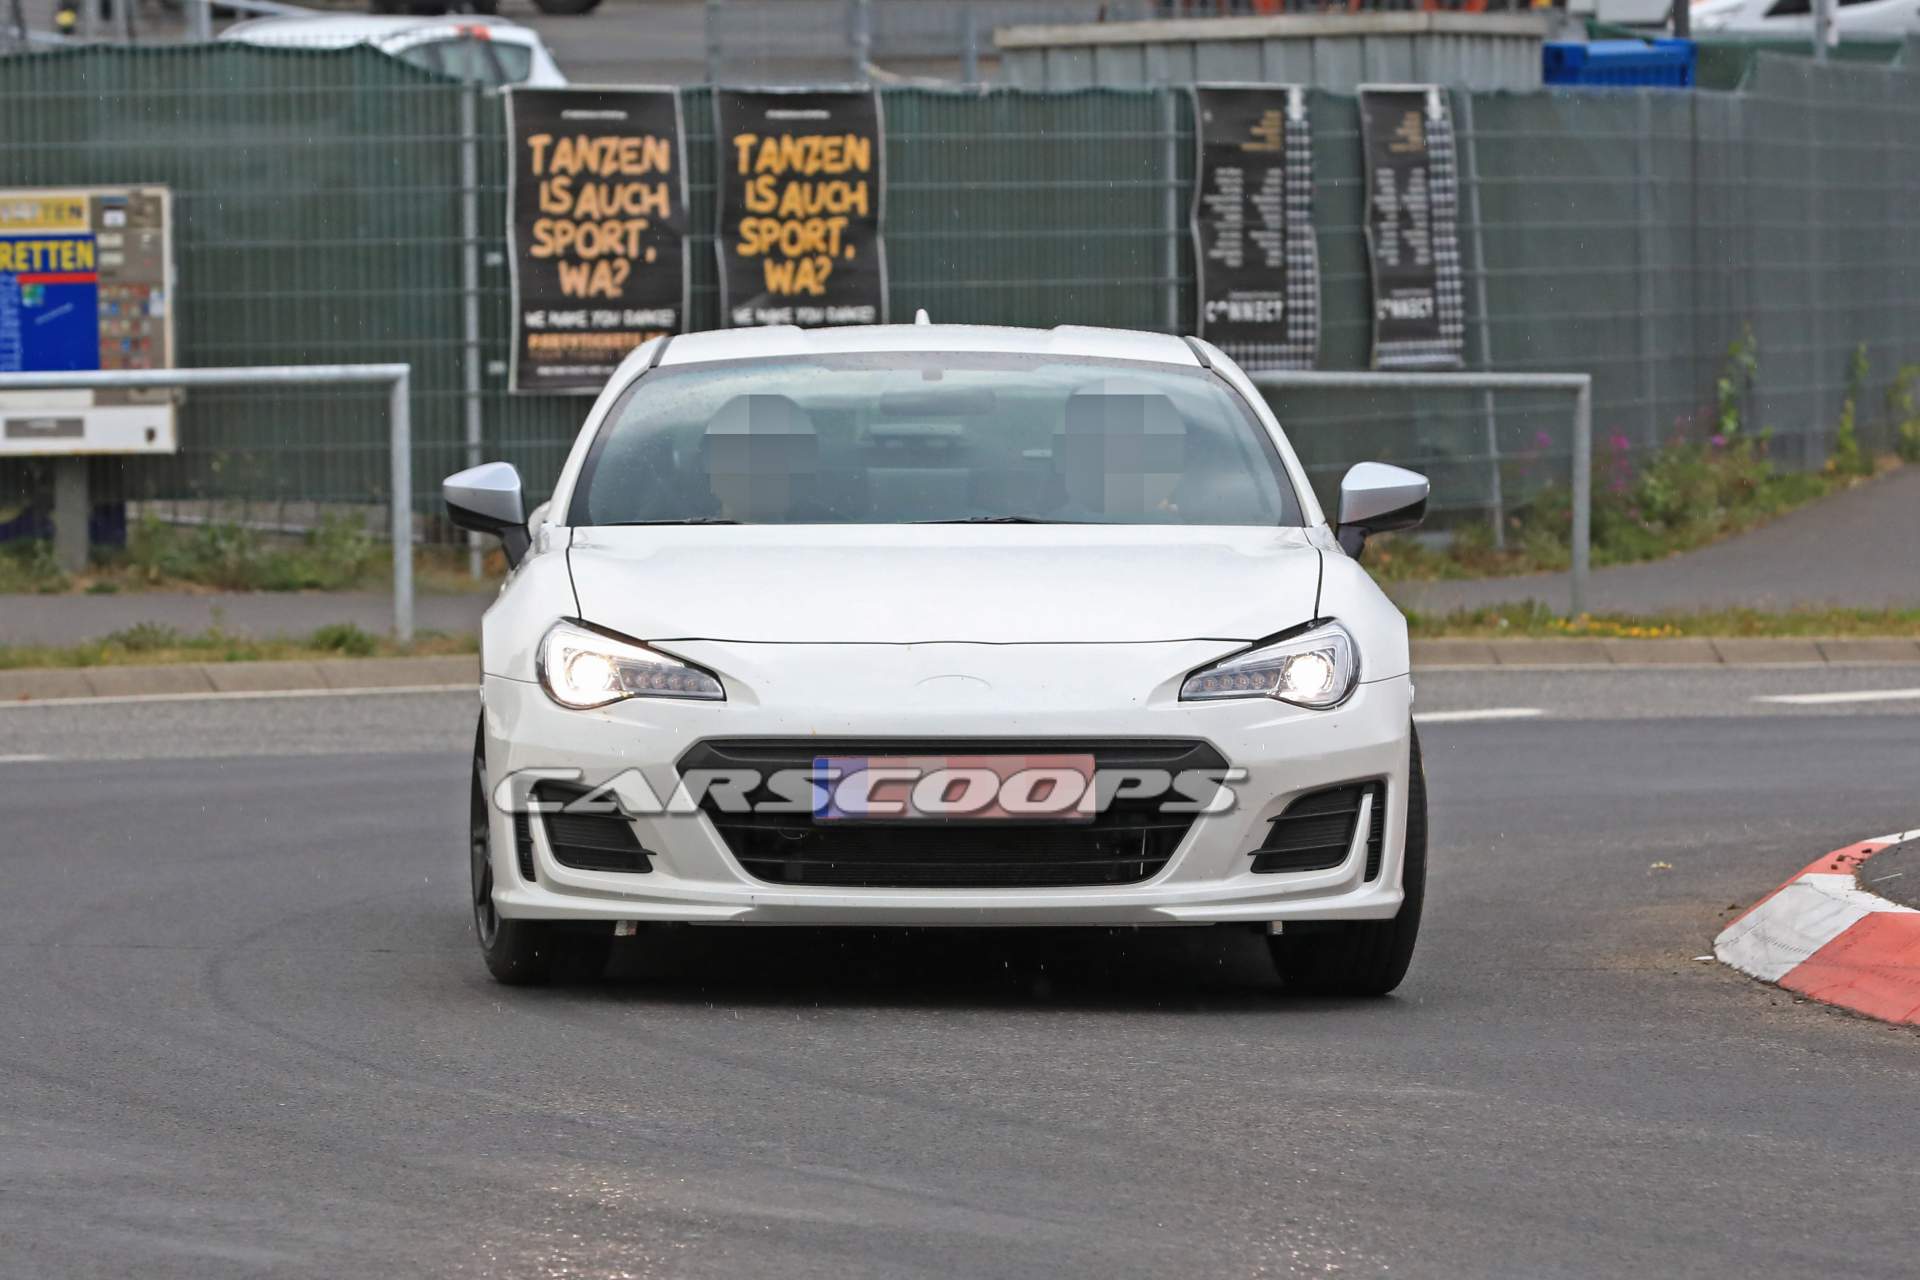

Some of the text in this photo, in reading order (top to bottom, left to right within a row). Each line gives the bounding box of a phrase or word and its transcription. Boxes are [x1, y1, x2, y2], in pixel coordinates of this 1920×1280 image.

[527, 133, 671, 177] TANZEN
[732, 133, 871, 176] TANZEN
[539, 175, 671, 220] IS AUCH
[744, 174, 869, 219] IS AUCH
[559, 258, 630, 297] WA?
[763, 256, 833, 296] WA?
